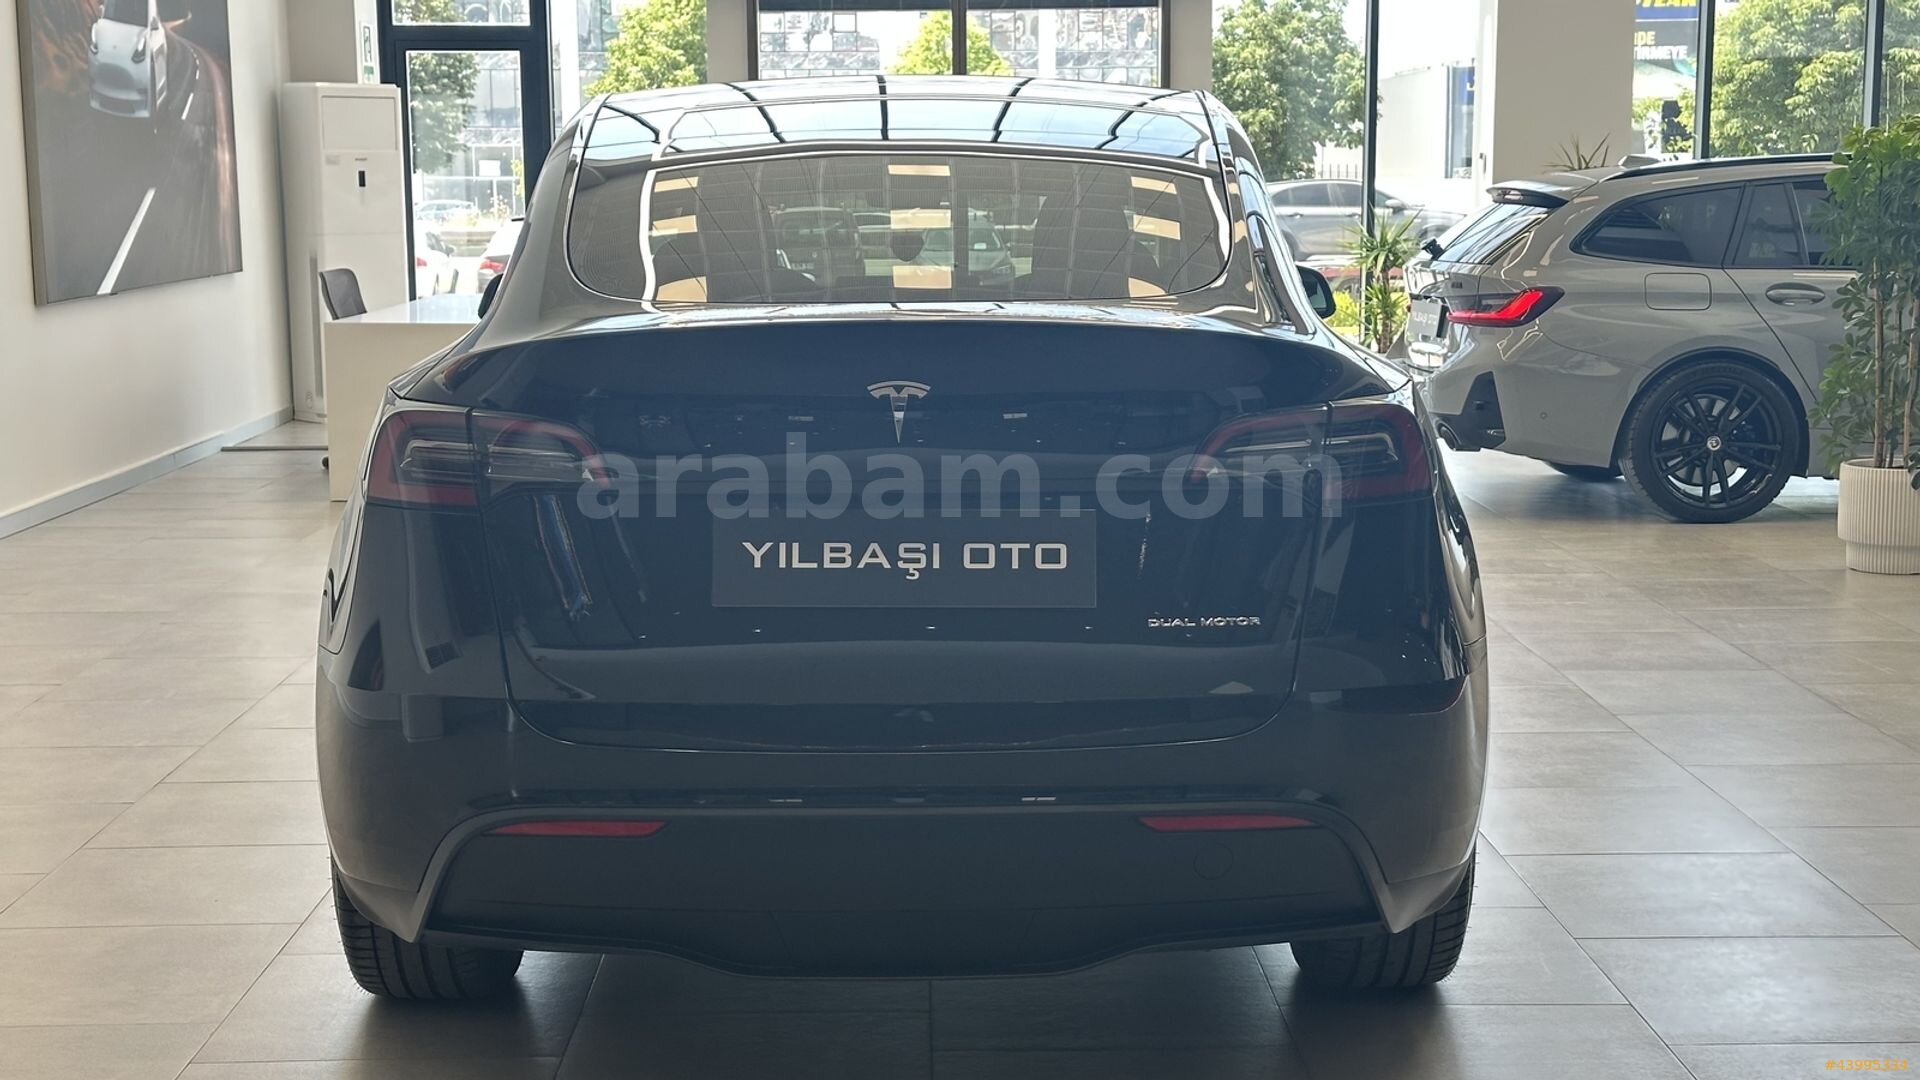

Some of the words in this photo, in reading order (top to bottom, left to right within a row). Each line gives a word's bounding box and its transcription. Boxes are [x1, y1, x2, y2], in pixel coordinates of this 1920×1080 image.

[742, 542, 940, 580] YILBAŞI
[963, 543, 1067, 569] OTO
[1148, 618, 1196, 627] DUAL
[1200, 616, 1261, 626] MOTOR
